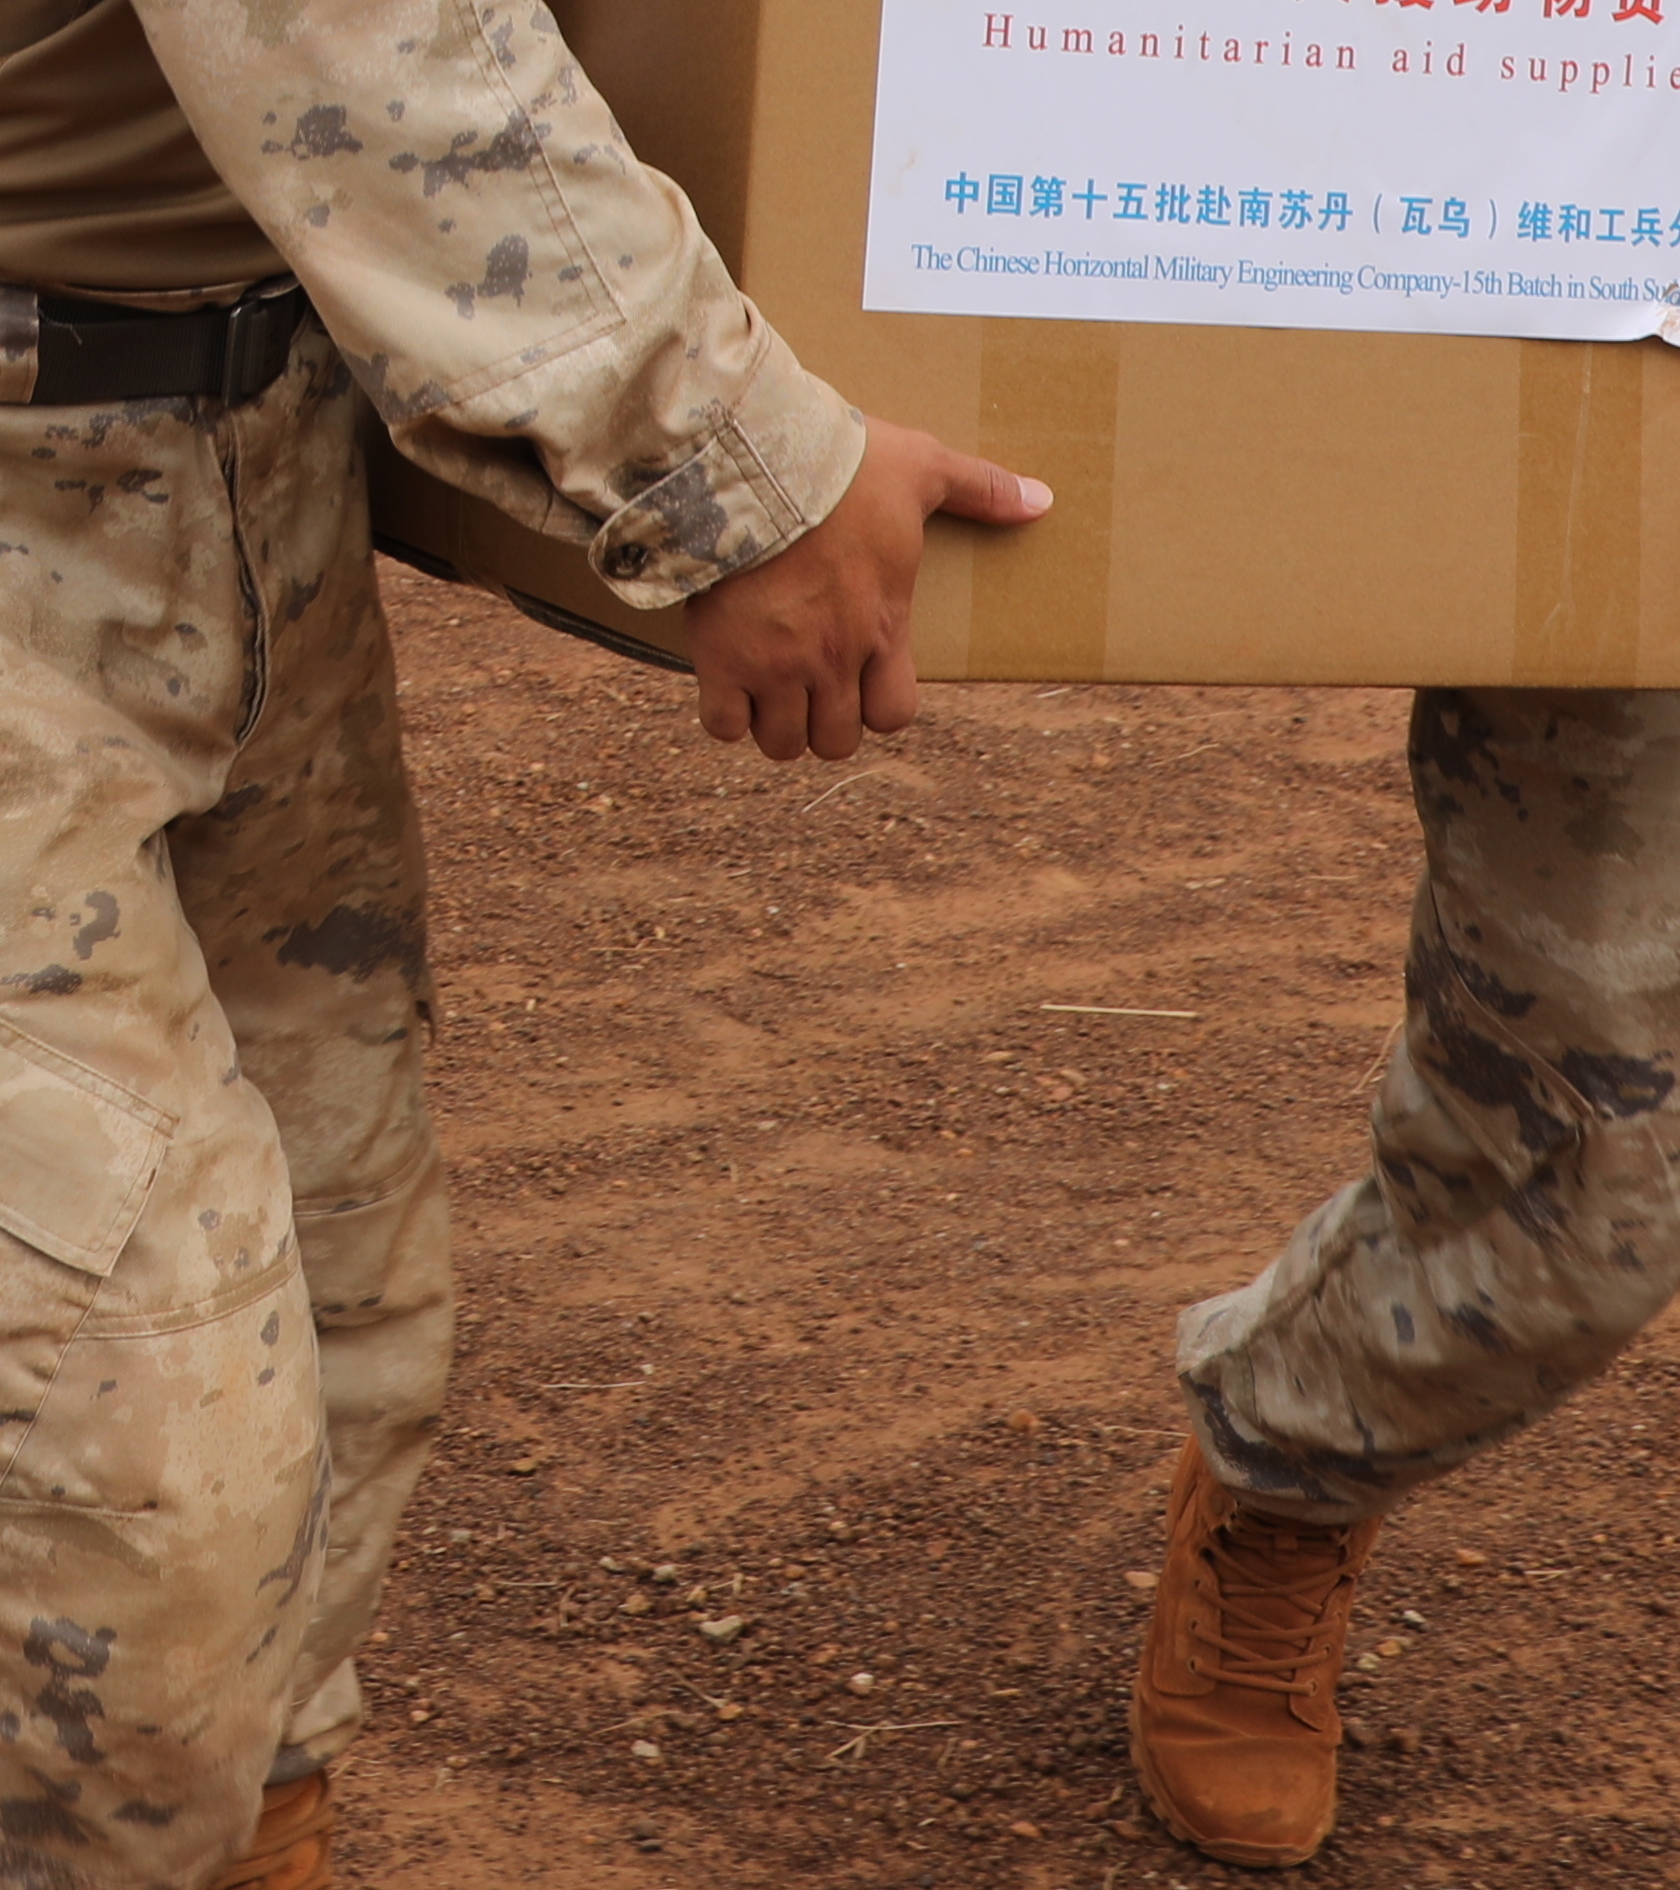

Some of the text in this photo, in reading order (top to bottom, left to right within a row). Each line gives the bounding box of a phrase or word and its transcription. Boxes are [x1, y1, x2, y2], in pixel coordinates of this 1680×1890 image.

[981, 12, 1356, 71] Humanitarian
[1391, 39, 1467, 78] aid
[911, 244, 953, 273] The
[956, 246, 1040, 276] Chinese
[1044, 251, 1149, 281] Horizontal
[1154, 255, 1234, 291] Military
[1237, 259, 1354, 296] Engineering
[1357, 264, 1503, 300] Company-15th
[1507, 271, 1564, 300] Batch
[1566, 273, 1585, 299] in
[1589, 274, 1639, 302] South
